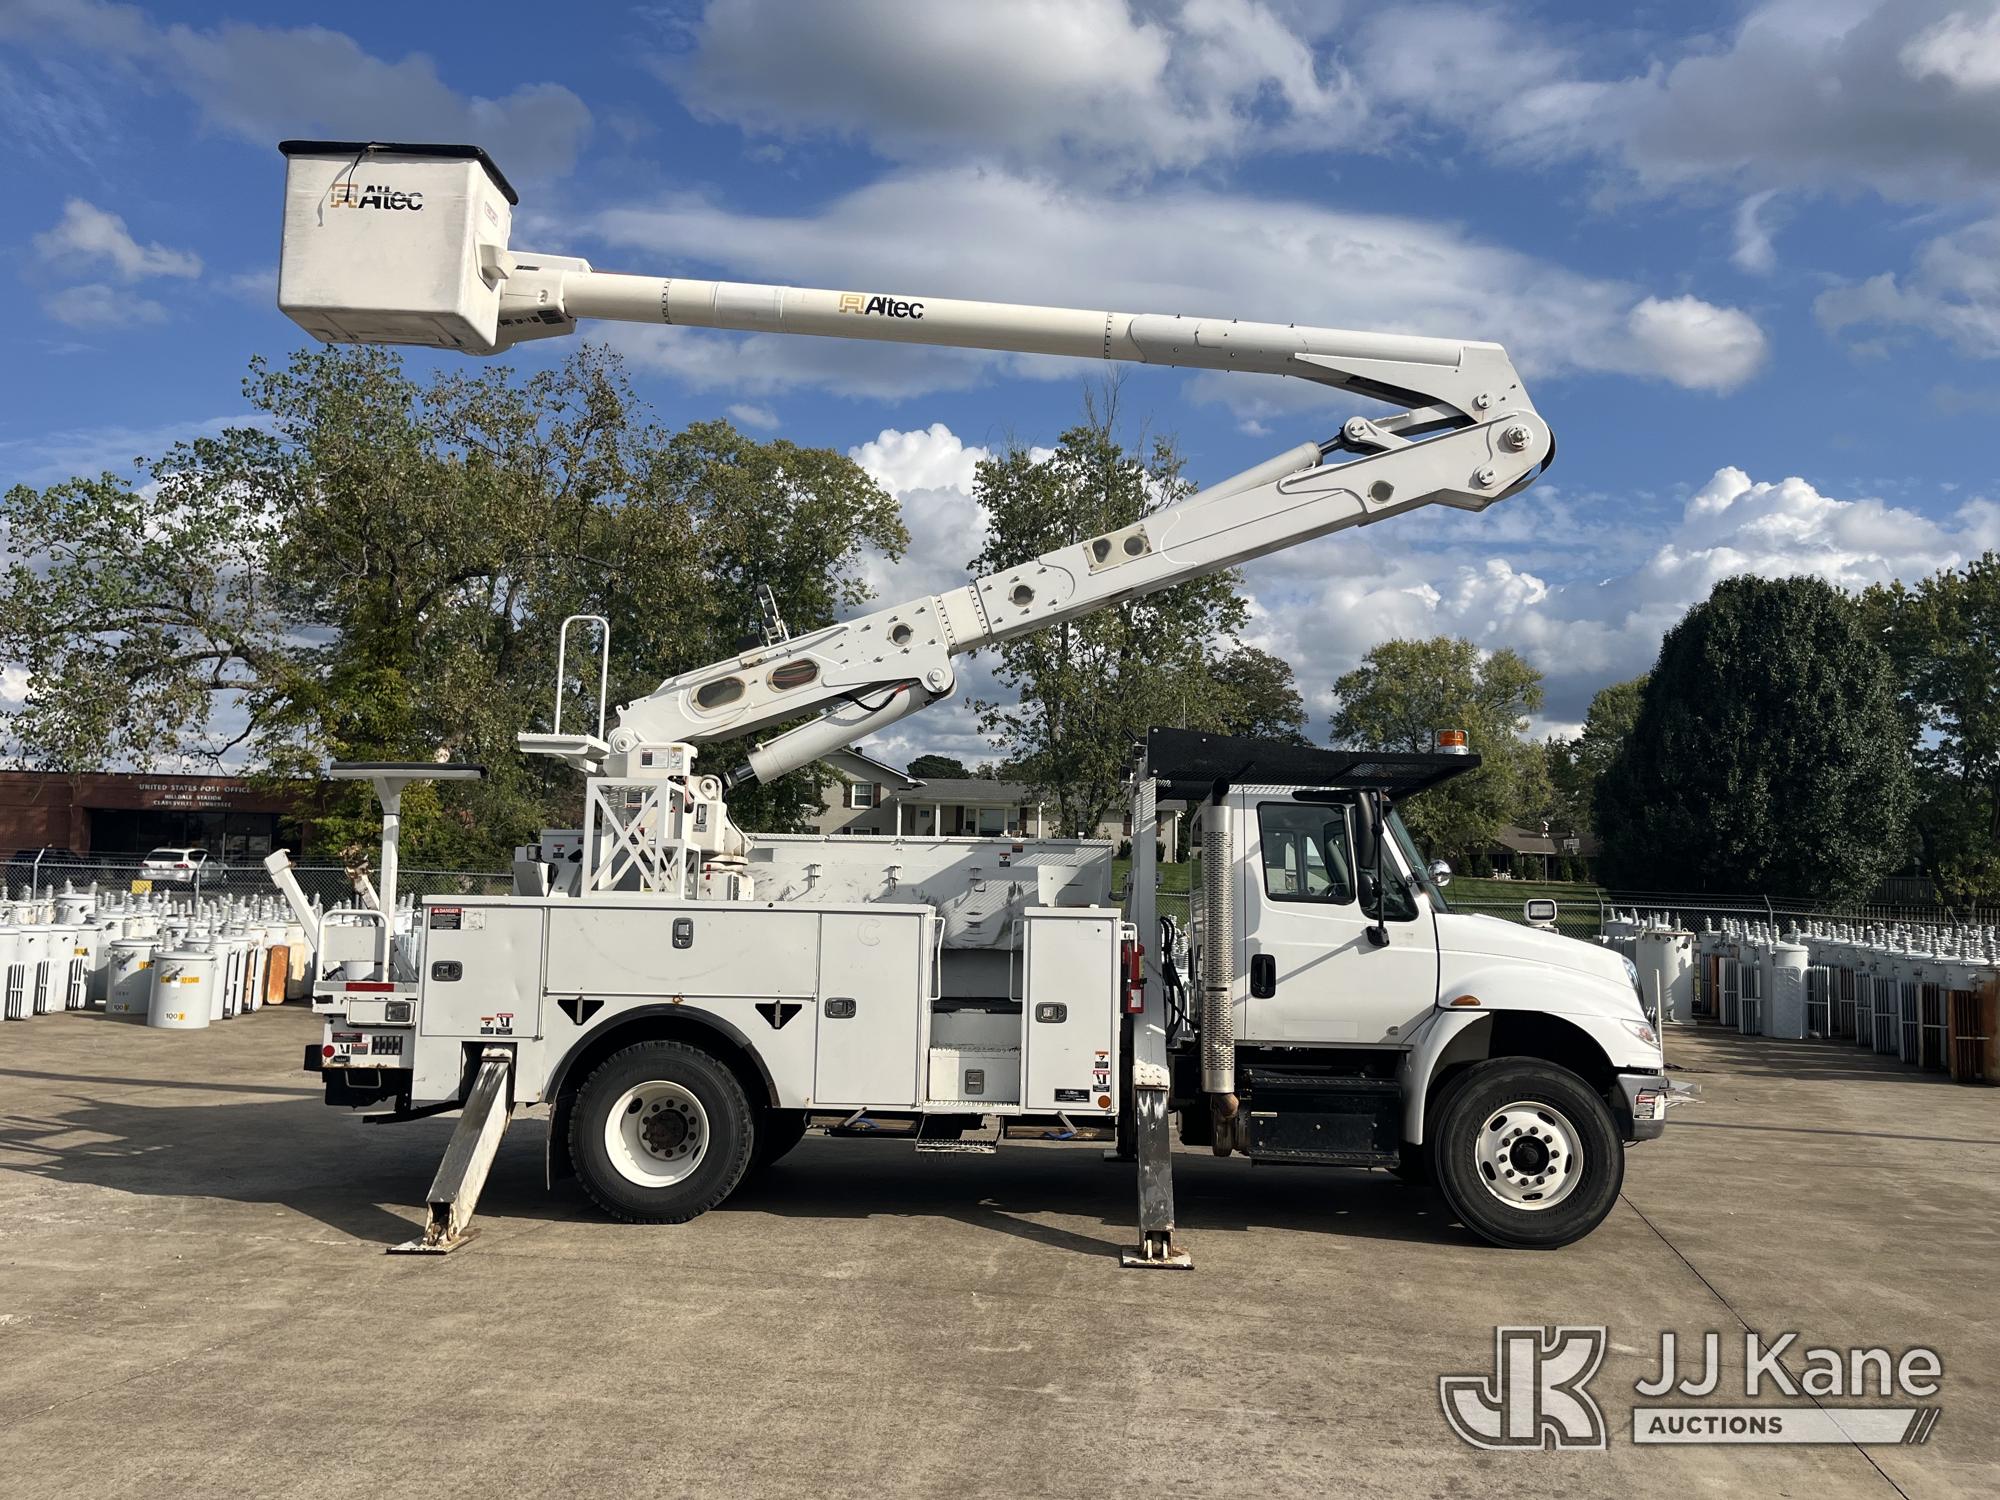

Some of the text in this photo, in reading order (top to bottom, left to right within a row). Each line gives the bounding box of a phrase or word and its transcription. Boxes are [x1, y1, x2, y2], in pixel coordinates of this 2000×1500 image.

[358, 185, 423, 210] Altec
[864, 296, 924, 320] Altec
[139, 783, 168, 791] UNITED
[170, 784, 198, 792] STATES
[165, 1012, 178, 1020] 100
